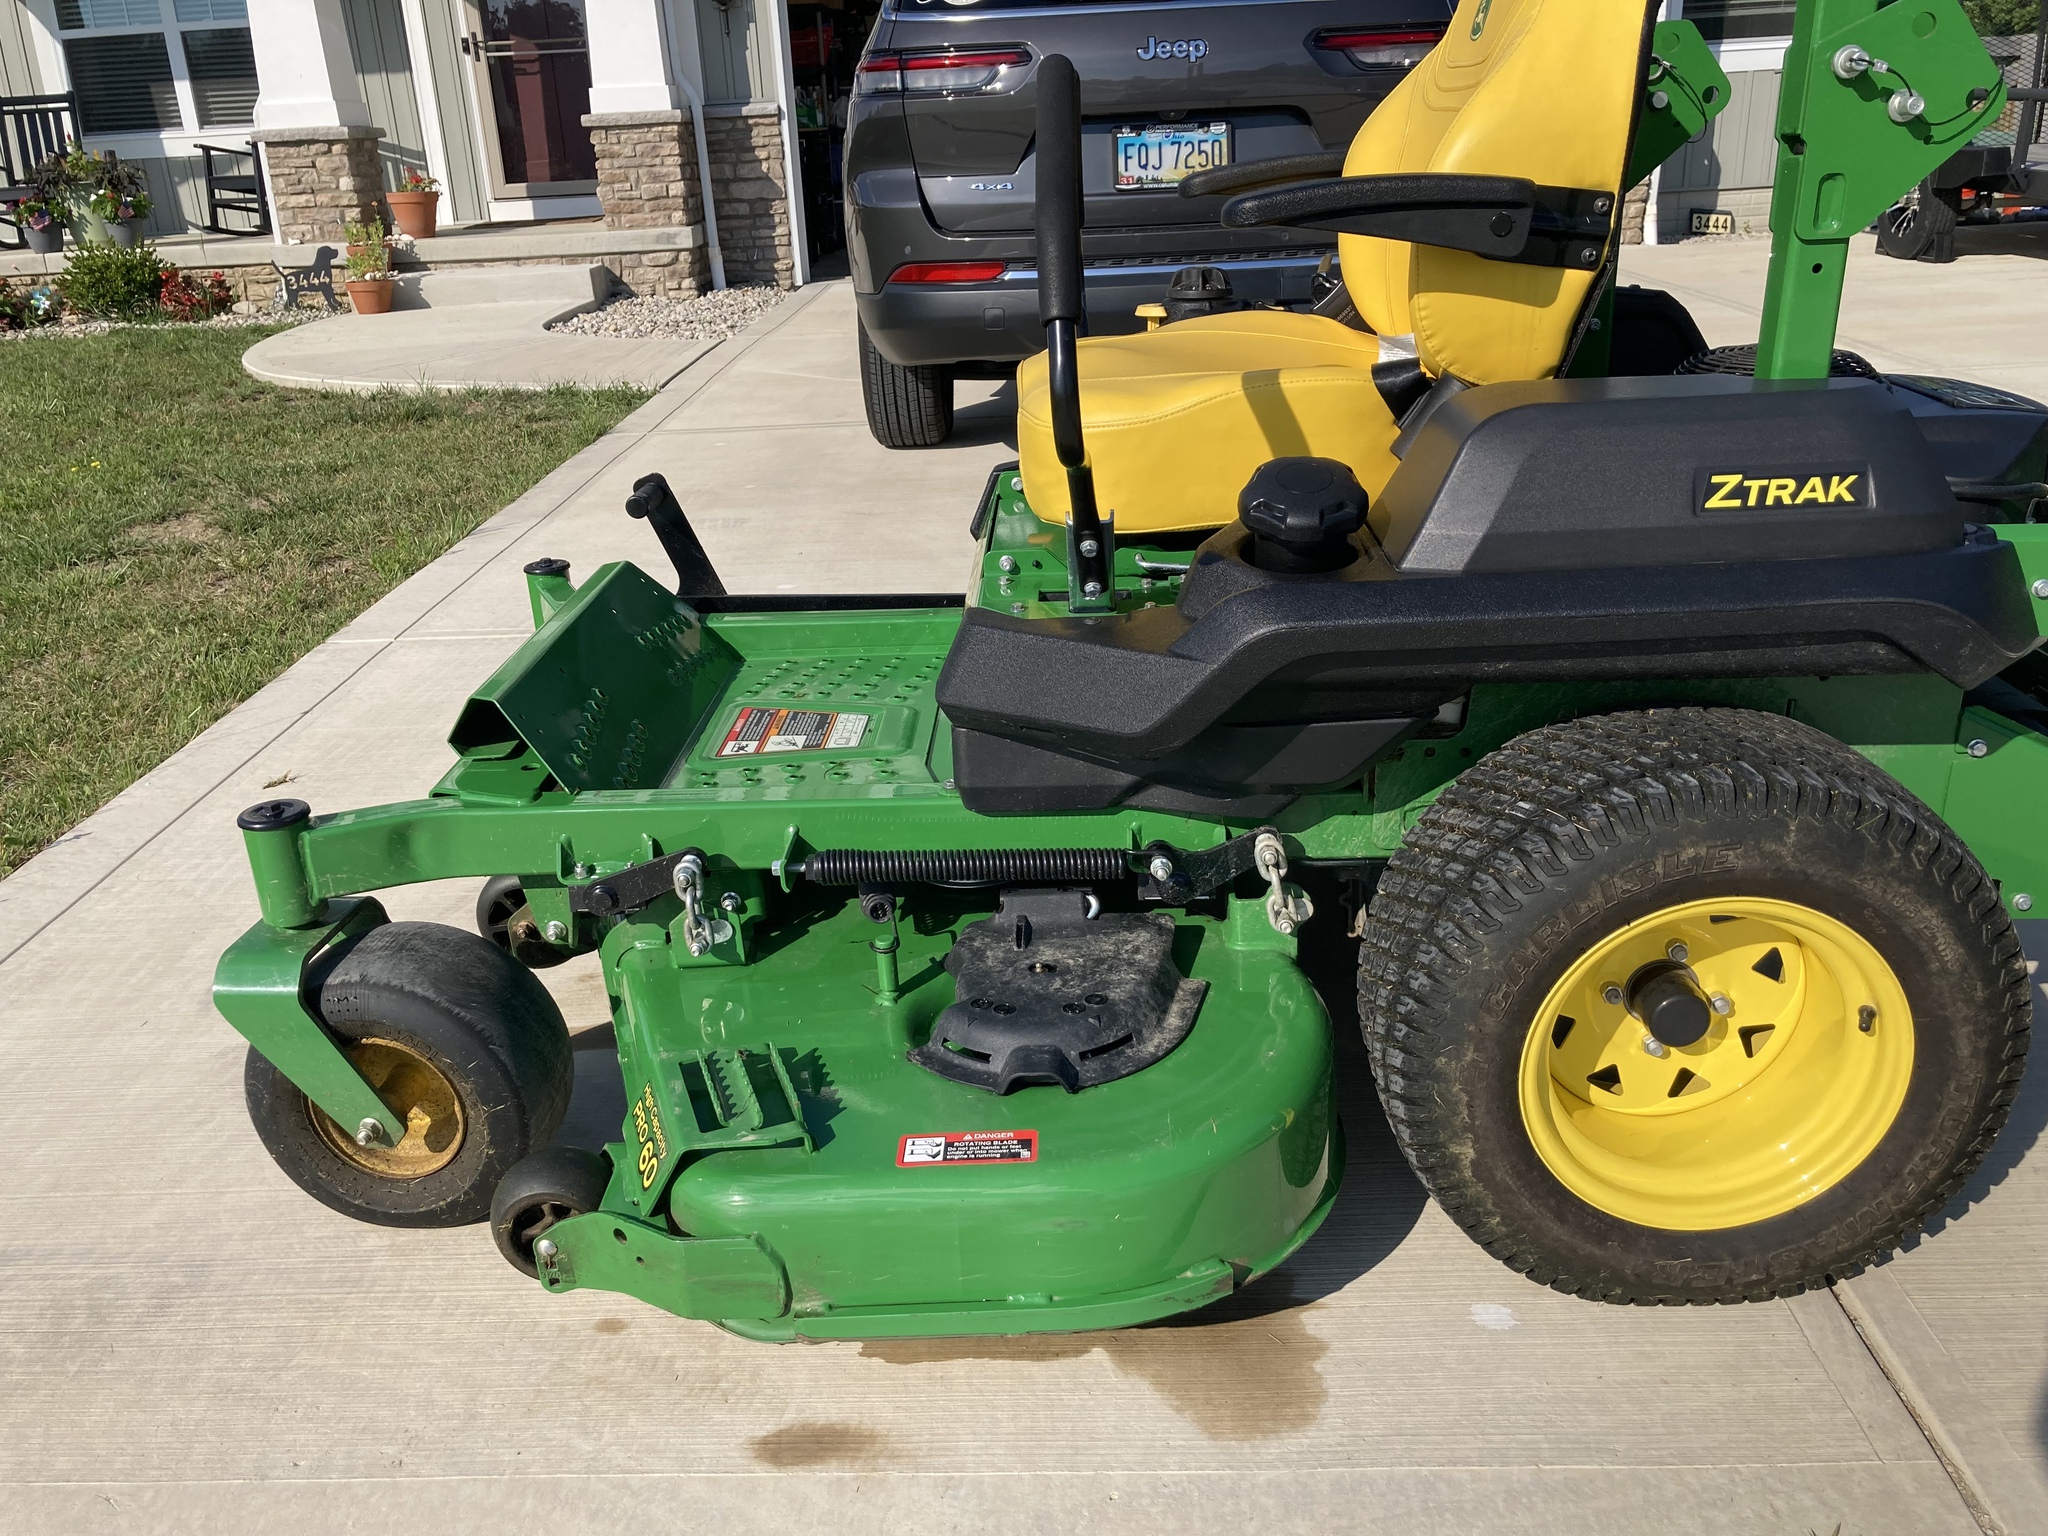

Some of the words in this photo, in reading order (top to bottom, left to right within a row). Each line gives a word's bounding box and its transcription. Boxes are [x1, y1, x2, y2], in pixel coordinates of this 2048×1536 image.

[1137, 36, 1208, 63] Jeep
[1156, 122, 1198, 130] PERFORMANCE
[1124, 141, 1162, 172] FQJ
[1171, 139, 1223, 170] 7250
[1695, 215, 1728, 231] 3444
[286, 270, 330, 290] 3444
[1704, 474, 1859, 509] ZTRAK
[1481, 843, 1743, 1022] CARLISLE
[633, 1099, 649, 1143] PRO
[644, 1082, 654, 1111] High
[650, 1106, 667, 1159] Capacity
[639, 1140, 658, 1188] 60
[1650, 1197, 1893, 1288] MASTER
